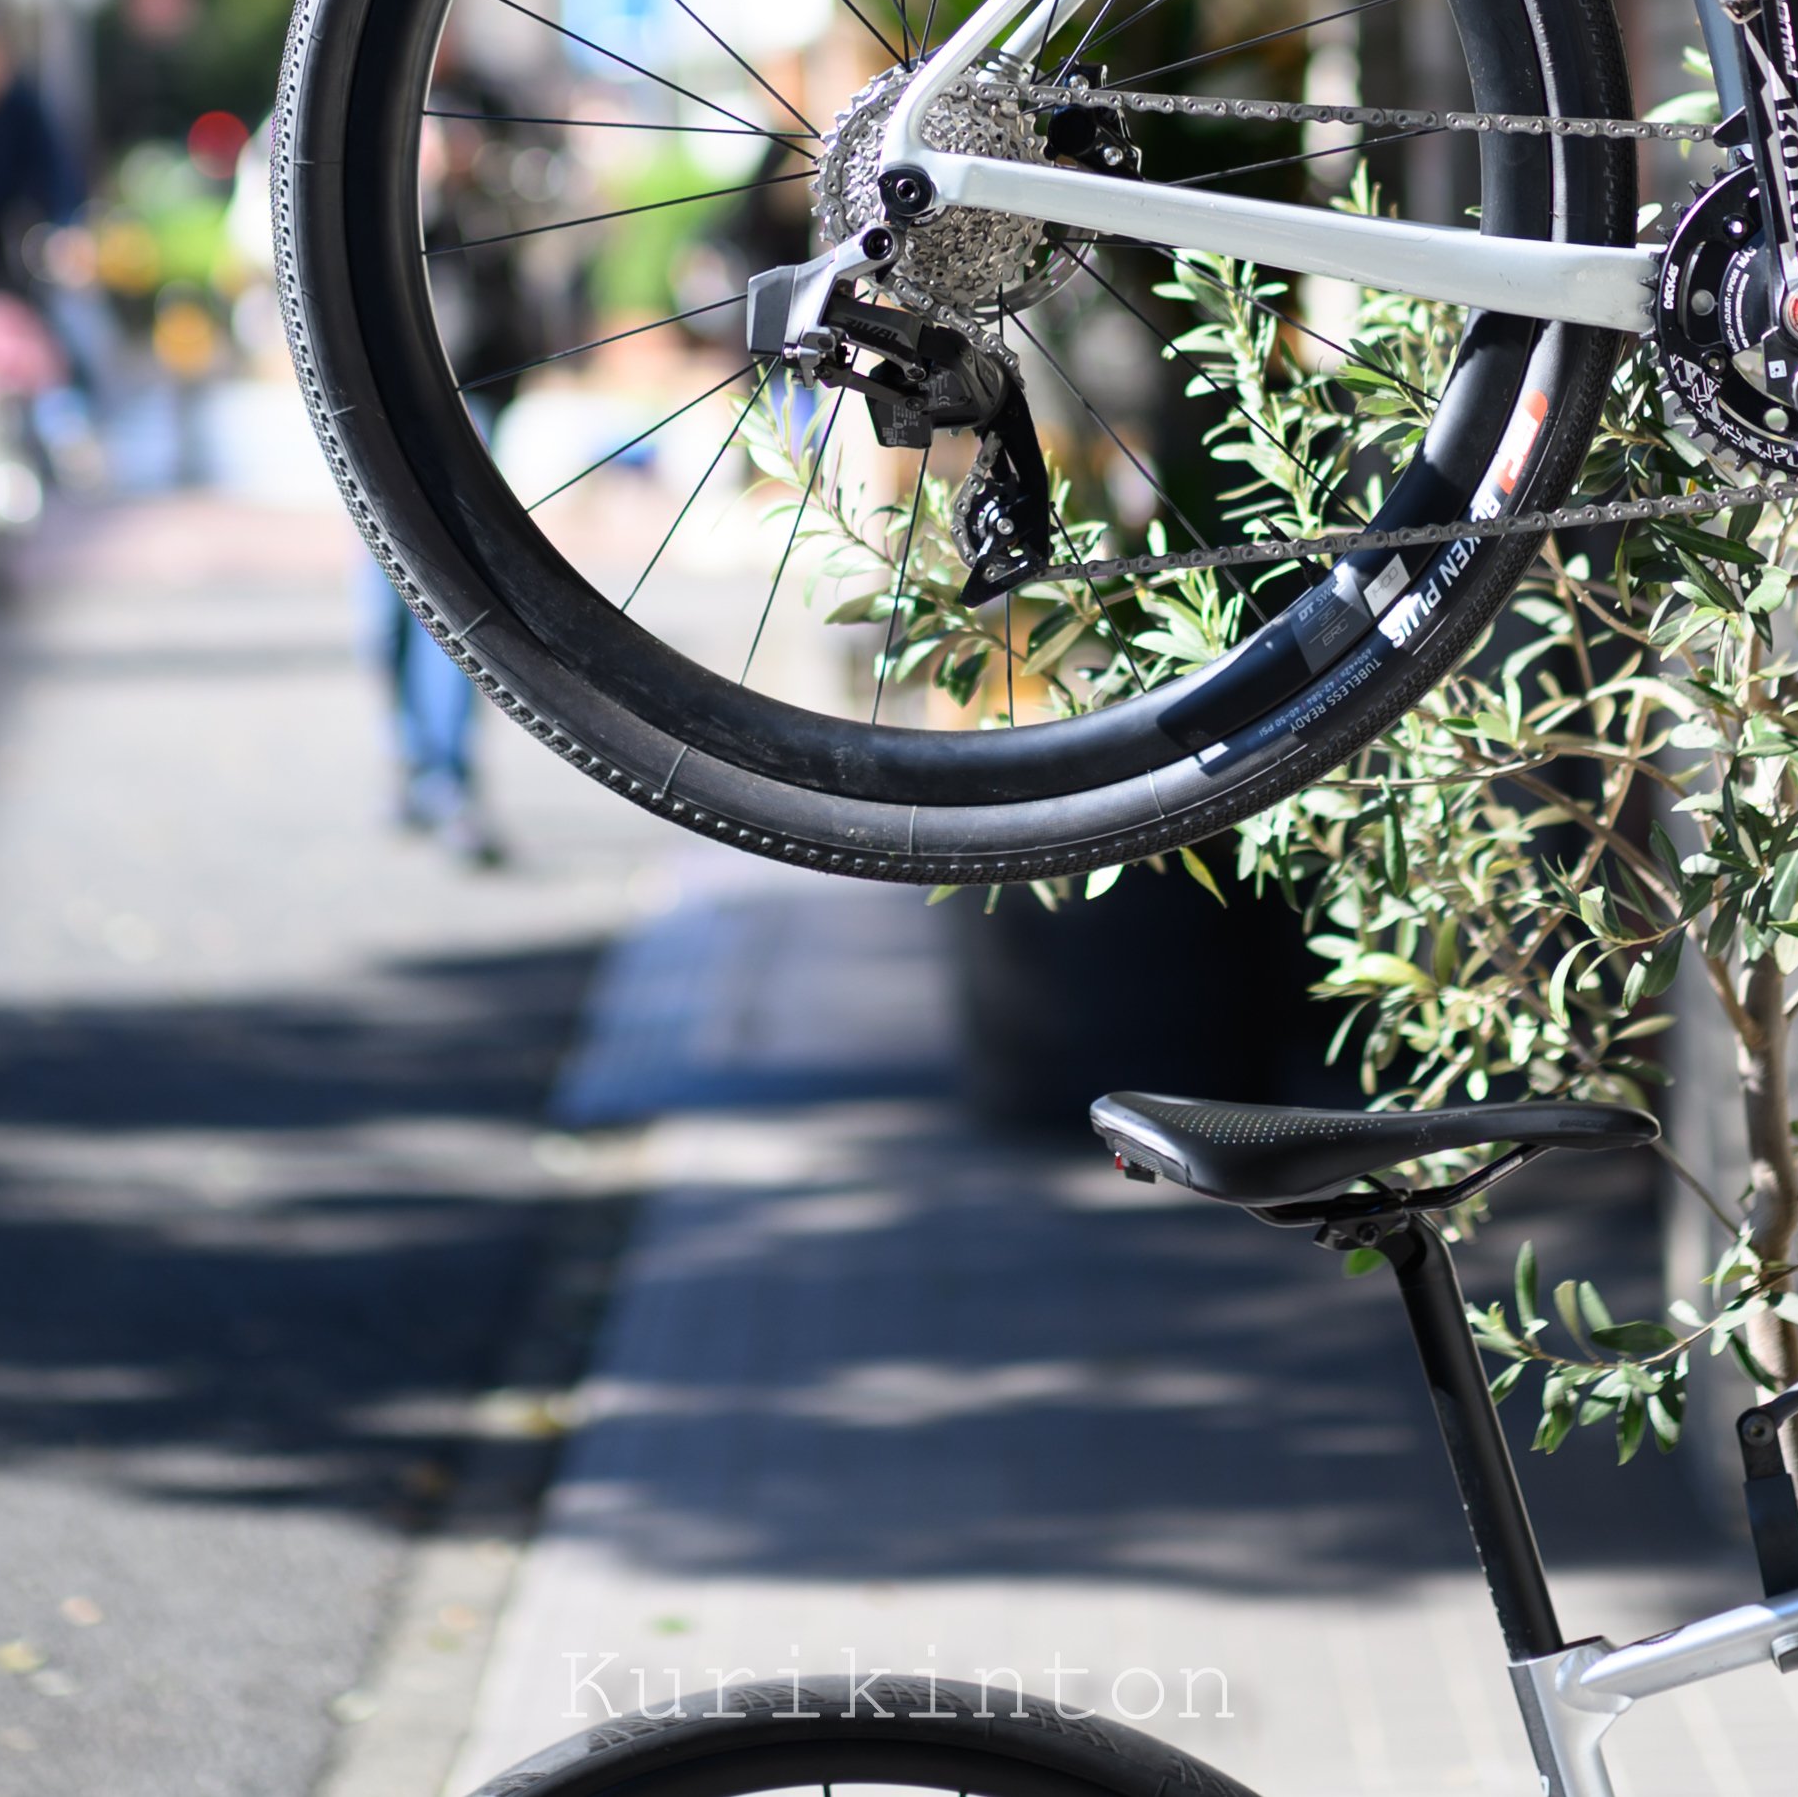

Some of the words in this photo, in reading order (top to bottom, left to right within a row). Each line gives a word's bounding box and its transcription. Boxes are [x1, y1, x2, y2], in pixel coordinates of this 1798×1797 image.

[1663, 262, 1680, 311] DECKAS
[1298, 603, 1315, 622] DT
[1318, 609, 1337, 627] 35
[1322, 619, 1350, 648] ERC
[1326, 657, 1383, 707] TUBELESS
[1258, 723, 1275, 737] PSI
[1290, 702, 1327, 734] READY
